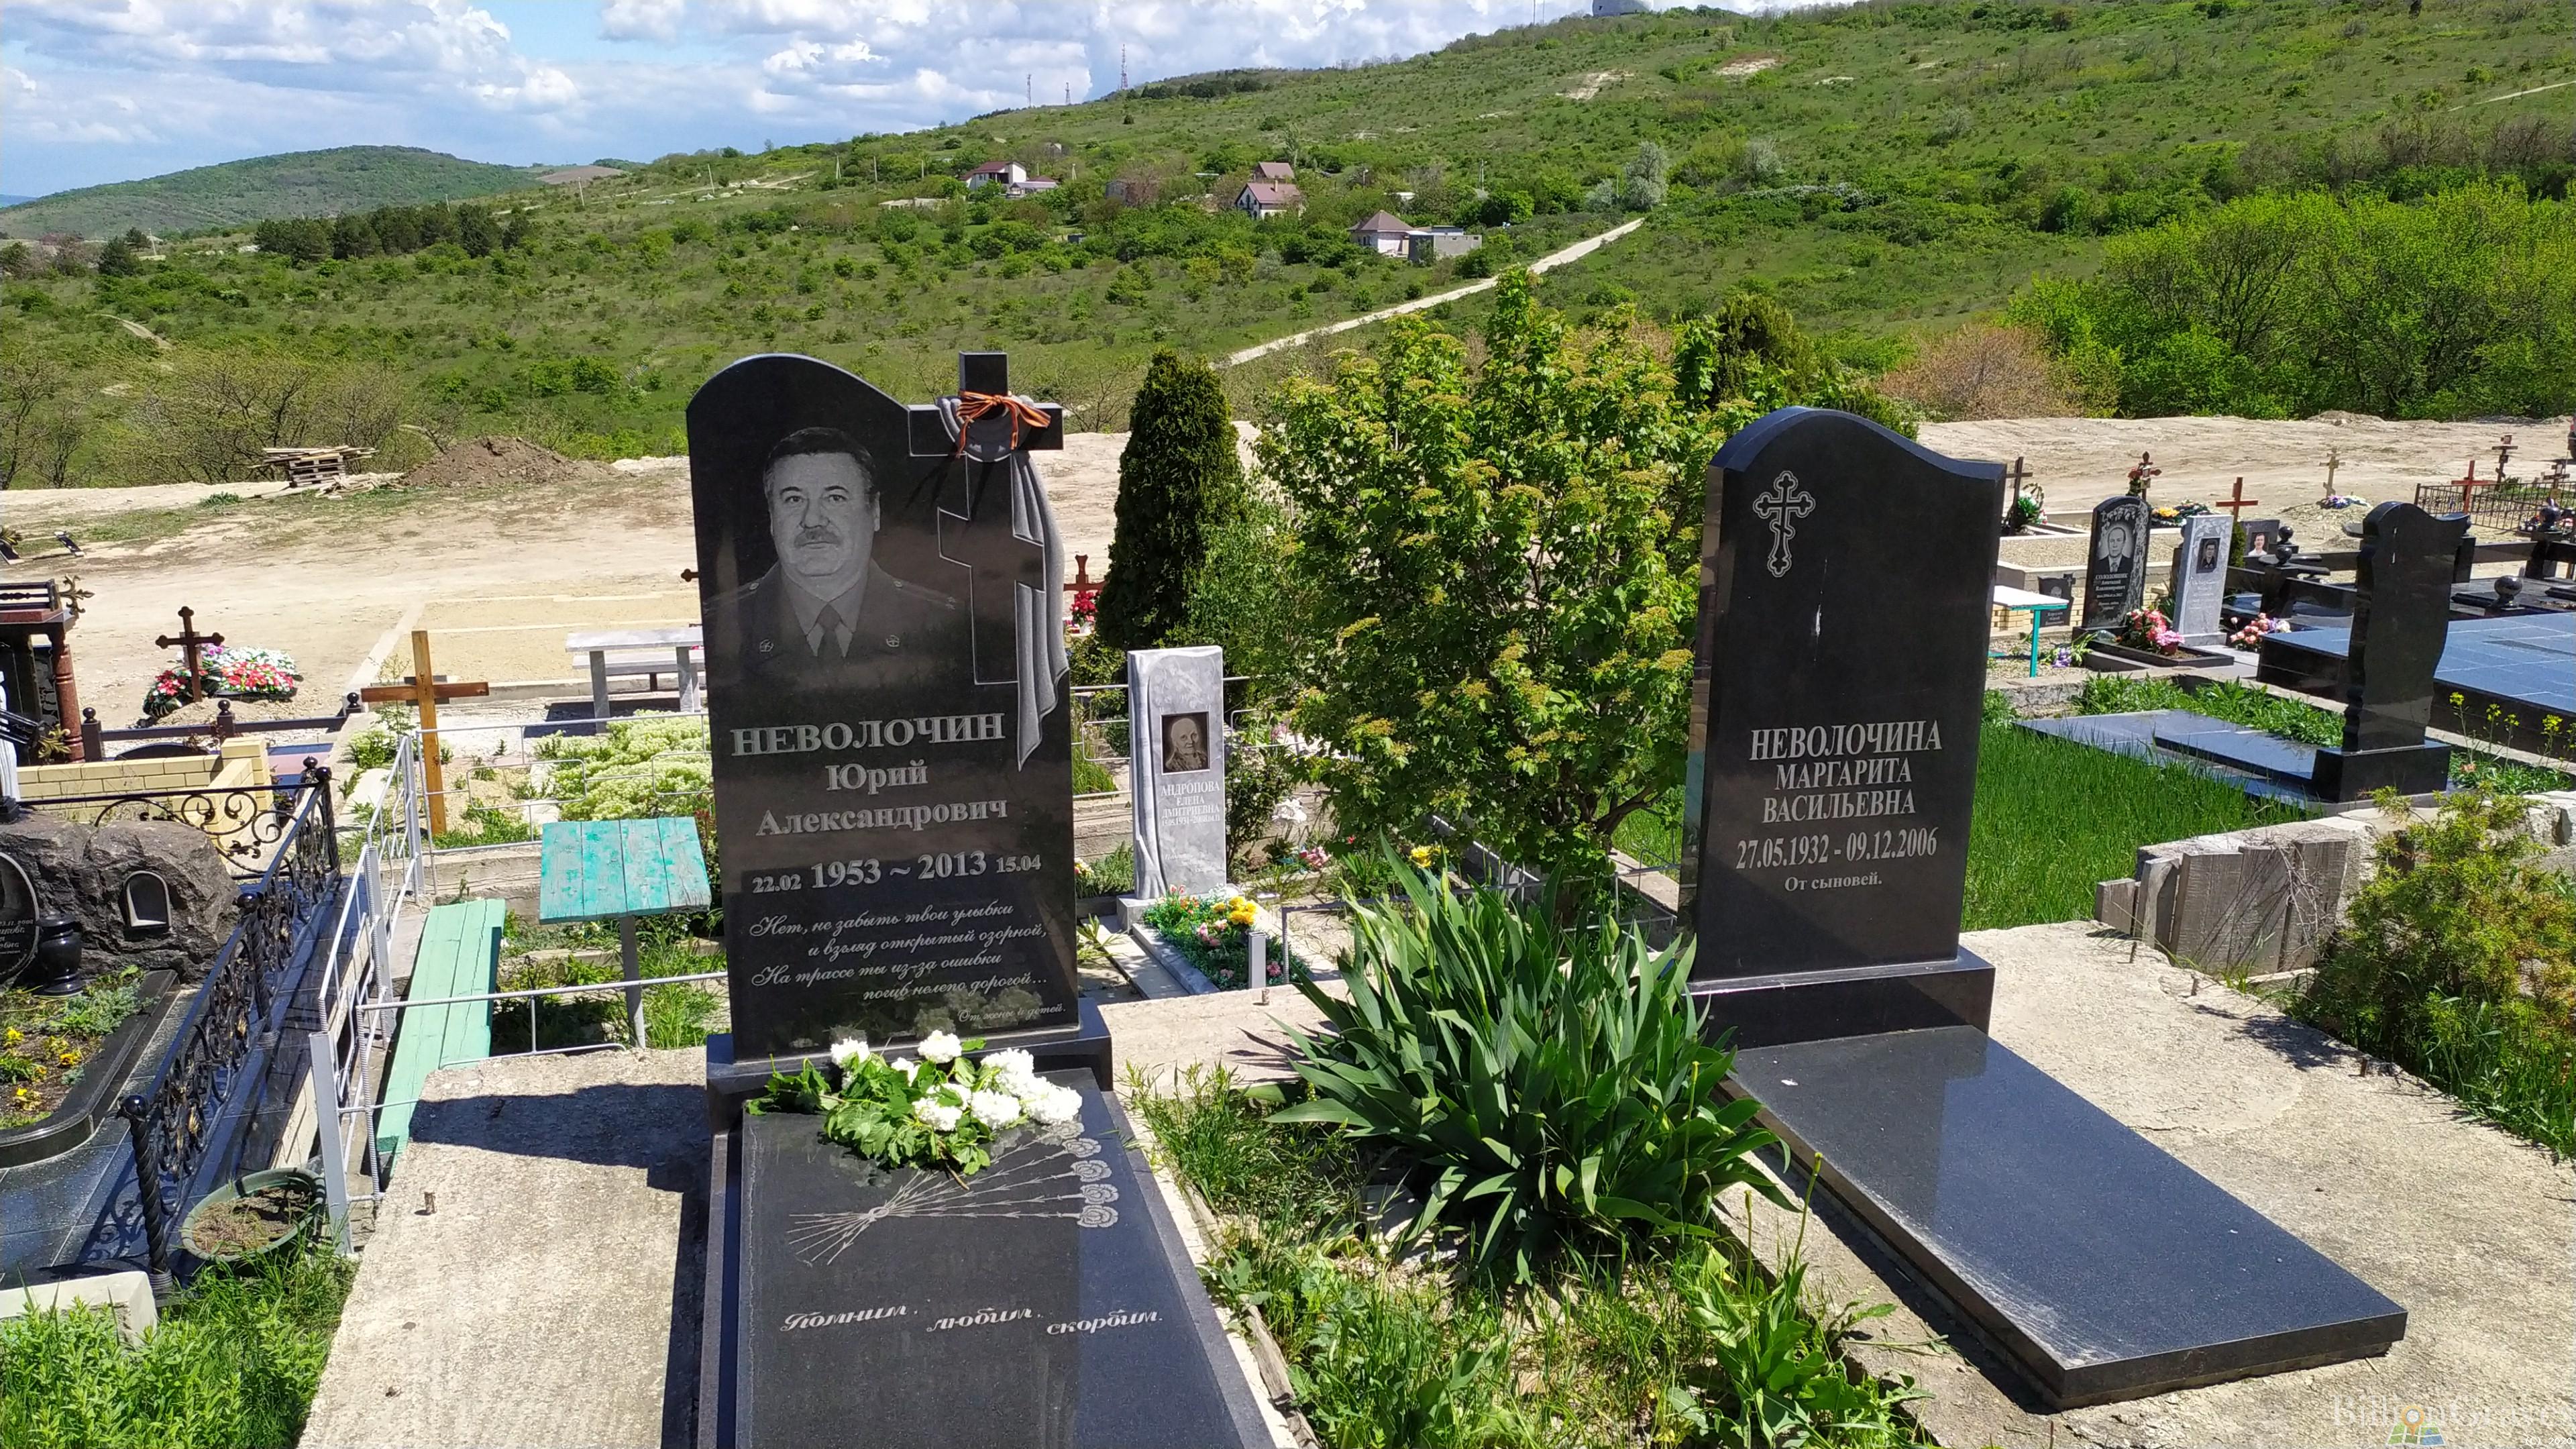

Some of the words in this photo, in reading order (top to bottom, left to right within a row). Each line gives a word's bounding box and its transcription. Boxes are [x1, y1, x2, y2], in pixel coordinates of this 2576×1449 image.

[730, 712, 1006, 756] НЕВОЛОЧИН
[1749, 720, 1943, 760] НЕВОЛОЧИНА
[825, 759, 928, 795] Юрий
[1161, 781, 1220, 797] АНДРОПОВА
[1774, 757, 1913, 790] МАРГАРИТА
[755, 800, 1008, 836] Александрович
[1161, 804, 1220, 819] ДМИТРИЕВНА
[1177, 796, 1205, 806] ЕЛЕНА
[1762, 789, 1916, 823] ВАСИЛЬЕВНА
[1735, 834, 1829, 869] 27.05.1932
[1846, 827, 1939, 862] 09.12.2006
[751, 874, 802, 894] 22.02
[810, 859, 881, 889] 1953
[917, 850, 987, 880] 2013
[996, 855, 1041, 873] 15.04
[1784, 877, 1807, 892] От
[1811, 871, 1882, 890] сыновей.
[749, 914, 808, 936] Нет,
[811, 923, 833, 932] не
[832, 910, 902, 937] забыть
[905, 904, 949, 924] твои
[951, 899, 1014, 926] улыбки
[808, 946, 819, 957] и
[823, 938, 877, 962] взгляд
[880, 929, 976, 953] открытый
[979, 923, 1048, 948] озорной,
[751, 965, 792, 987] На
[795, 967, 855, 988] трассе
[858, 964, 889, 977] ты
[891, 961, 938, 981] из-за
[940, 948, 1002, 968] ошибки
[863, 979, 914, 1000] погиб
[912, 981, 967, 996] нелепо
[957, 1008, 981, 1022] От
[983, 1010, 1016, 1020] жены
[1017, 1006, 1026, 1016] и
[1025, 1003, 1066, 1020] детей.
[1046, 1309, 1163, 1335] скорбим.
